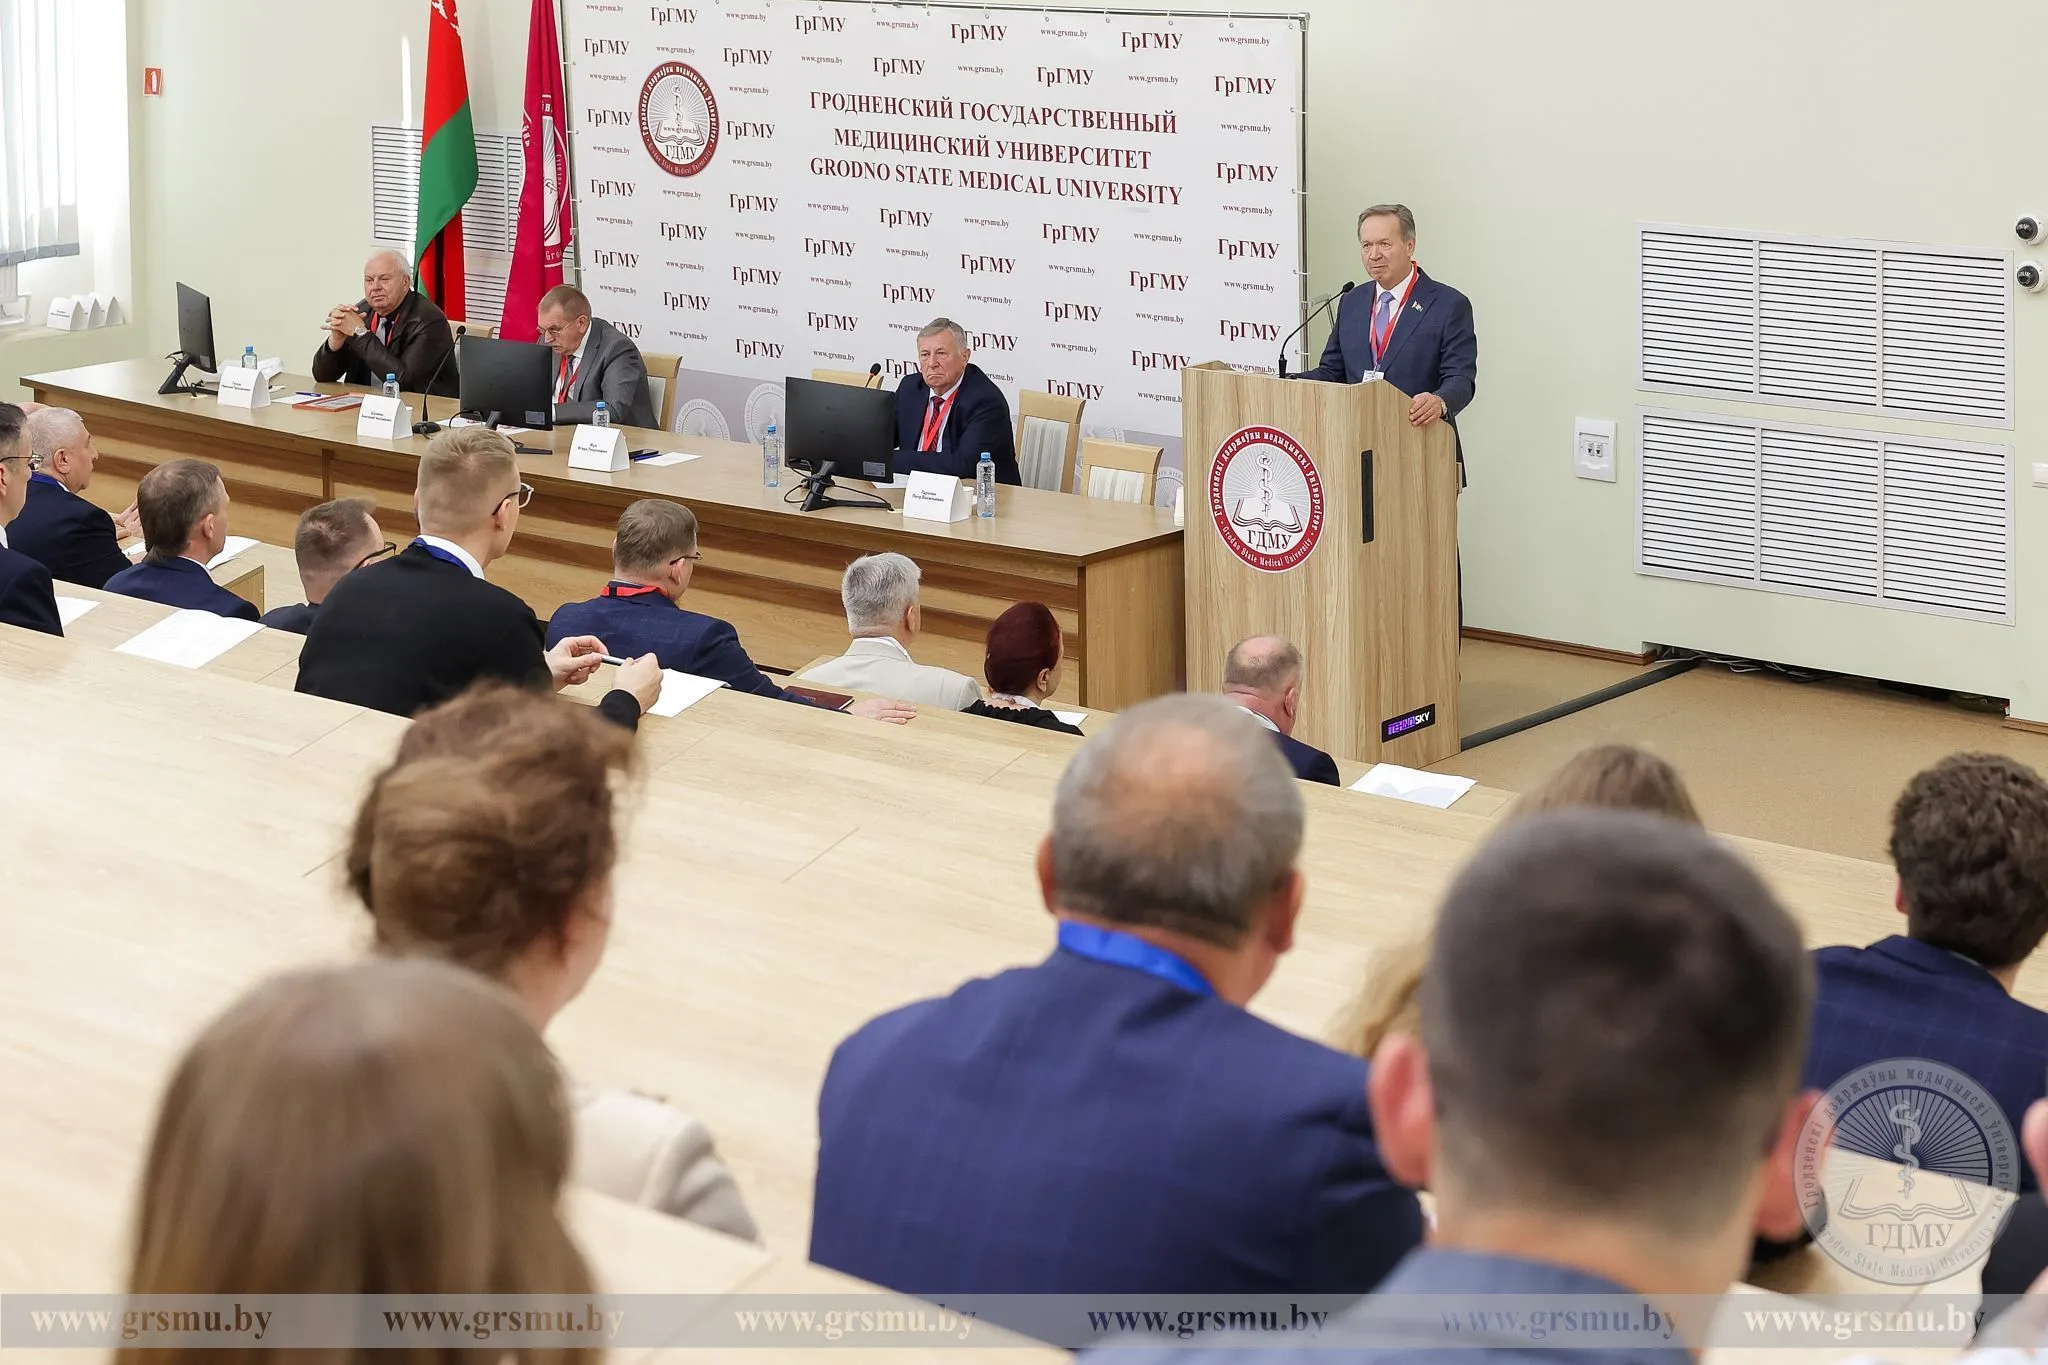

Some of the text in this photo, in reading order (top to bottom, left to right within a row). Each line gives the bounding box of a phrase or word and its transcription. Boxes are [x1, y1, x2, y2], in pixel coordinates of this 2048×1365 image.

[650, 7, 698, 26] ГрГМУ
[726, 13, 766, 23] www.grsmu.by
[796, 15, 846, 34] ГрГМУ
[876, 21, 919, 31] www.grsmu.by
[951, 24, 1007, 43] ГрГМУ
[1041, 29, 1088, 39] www.grsmu.by
[1121, 32, 1183, 52] ГрГМУ
[1219, 37, 1270, 47] www.grsmu.by
[585, 38, 629, 57] ГрГМУ
[723, 48, 772, 67] ГрГМУ
[802, 56, 842, 66] www.grsmu.by
[873, 57, 925, 77] ГрГМУ
[958, 66, 1004, 76] www.grsmu.by
[1037, 67, 1094, 87] ГрГМУ
[1128, 73, 1178, 85] www.grsmu.by
[1214, 76, 1277, 97] ГрГМУ
[588, 108, 633, 127] ГрГМУ
[809, 91, 1178, 134] ГРОДНЕНСКИЙ ГОСУДАРСТВЕННЫЙ
[726, 121, 776, 140] ГрГМУ
[1221, 124, 1271, 135] www.grsmu.by
[665, 145, 698, 162] ГДМУ
[833, 128, 1152, 170] МЕДИЦИНСКИЙ УНИВЕРСИТЕТ
[732, 160, 772, 170] www.grsmu.by
[1216, 162, 1278, 184] ГрГМУ
[591, 179, 636, 198] ГрГМУ
[811, 157, 1183, 206] GRODNO STATE MEDICAL UNIVERSITY
[729, 193, 778, 213] ГрГМУ
[808, 203, 849, 214] www.grsmu.by
[1223, 205, 1273, 216] www.grsmu.by
[880, 208, 933, 228] ГрГМУ
[964, 218, 1008, 229] www.grsmu.by
[660, 222, 707, 241] ГрГМУ
[735, 232, 775, 242] www.grsmu.by
[1042, 223, 1099, 244] ГрГМУ
[1134, 233, 1182, 244] www.grsmu.by
[804, 238, 856, 257] ГрГМУ
[886, 248, 928, 259] www.grsmu.by
[1218, 239, 1280, 263] ГрГМУ
[594, 250, 639, 268] ГрГМУ
[960, 254, 1016, 274] ГрГМУ
[732, 266, 781, 285] ГрГМУ
[1049, 265, 1095, 276] www.grsmu.by
[810, 277, 852, 288] www.grsmu.by
[1129, 271, 1189, 292] ГрГМУ
[1224, 282, 1274, 293] www.grsmu.by
[664, 292, 710, 311] ГрГМУ
[882, 283, 935, 303] ГрГМУ
[967, 295, 1012, 306] www.grsmu.by
[1044, 301, 1102, 322] ГрГМУ
[1136, 313, 1184, 325] www.grsmu.by
[808, 312, 858, 331] ГрГМУ
[1219, 320, 1281, 342] ГрГМУ
[736, 339, 784, 358] ГрГМУ
[813, 351, 855, 362] www.grsmu.by
[1051, 343, 1096, 355] www.grsmu.by
[1137, 391, 1182, 403] www.grsmu.b
[1247, 530, 1292, 552] ГДМУ
[1240, 547, 1258, 563] State
[1260, 556, 1284, 568] Medical
[1284, 537, 1314, 564] University
